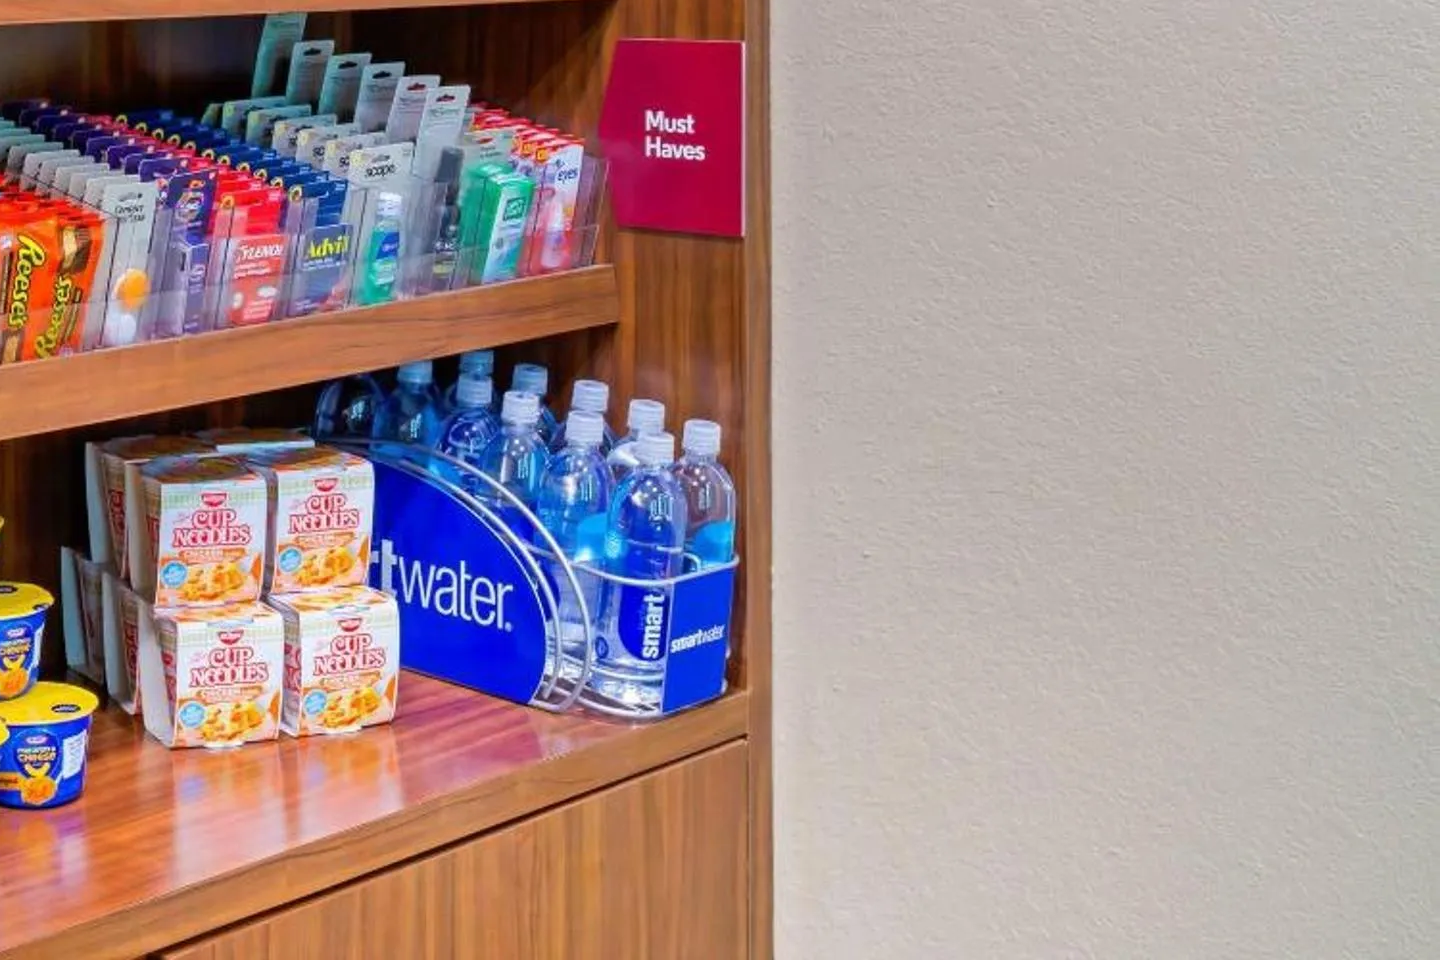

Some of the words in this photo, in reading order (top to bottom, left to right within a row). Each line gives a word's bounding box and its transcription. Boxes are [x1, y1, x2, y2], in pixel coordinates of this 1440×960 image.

[644, 109, 695, 134] Must
[644, 136, 706, 161] Haves
[364, 161, 397, 179] scope
[305, 235, 350, 259] Advil
[8, 232, 48, 329] Reese's
[33, 274, 74, 359] Reese's
[305, 493, 348, 515] CUP
[191, 509, 238, 530] CUP
[287, 508, 359, 534] NOODLES
[172, 524, 251, 548] NOODLES
[642, 592, 665, 660] smart
[670, 624, 726, 653] smartwater
[329, 632, 373, 656] CUP
[208, 647, 254, 669] CUP
[312, 648, 386, 676] NOODLES
[189, 662, 270, 688] NOODLES
